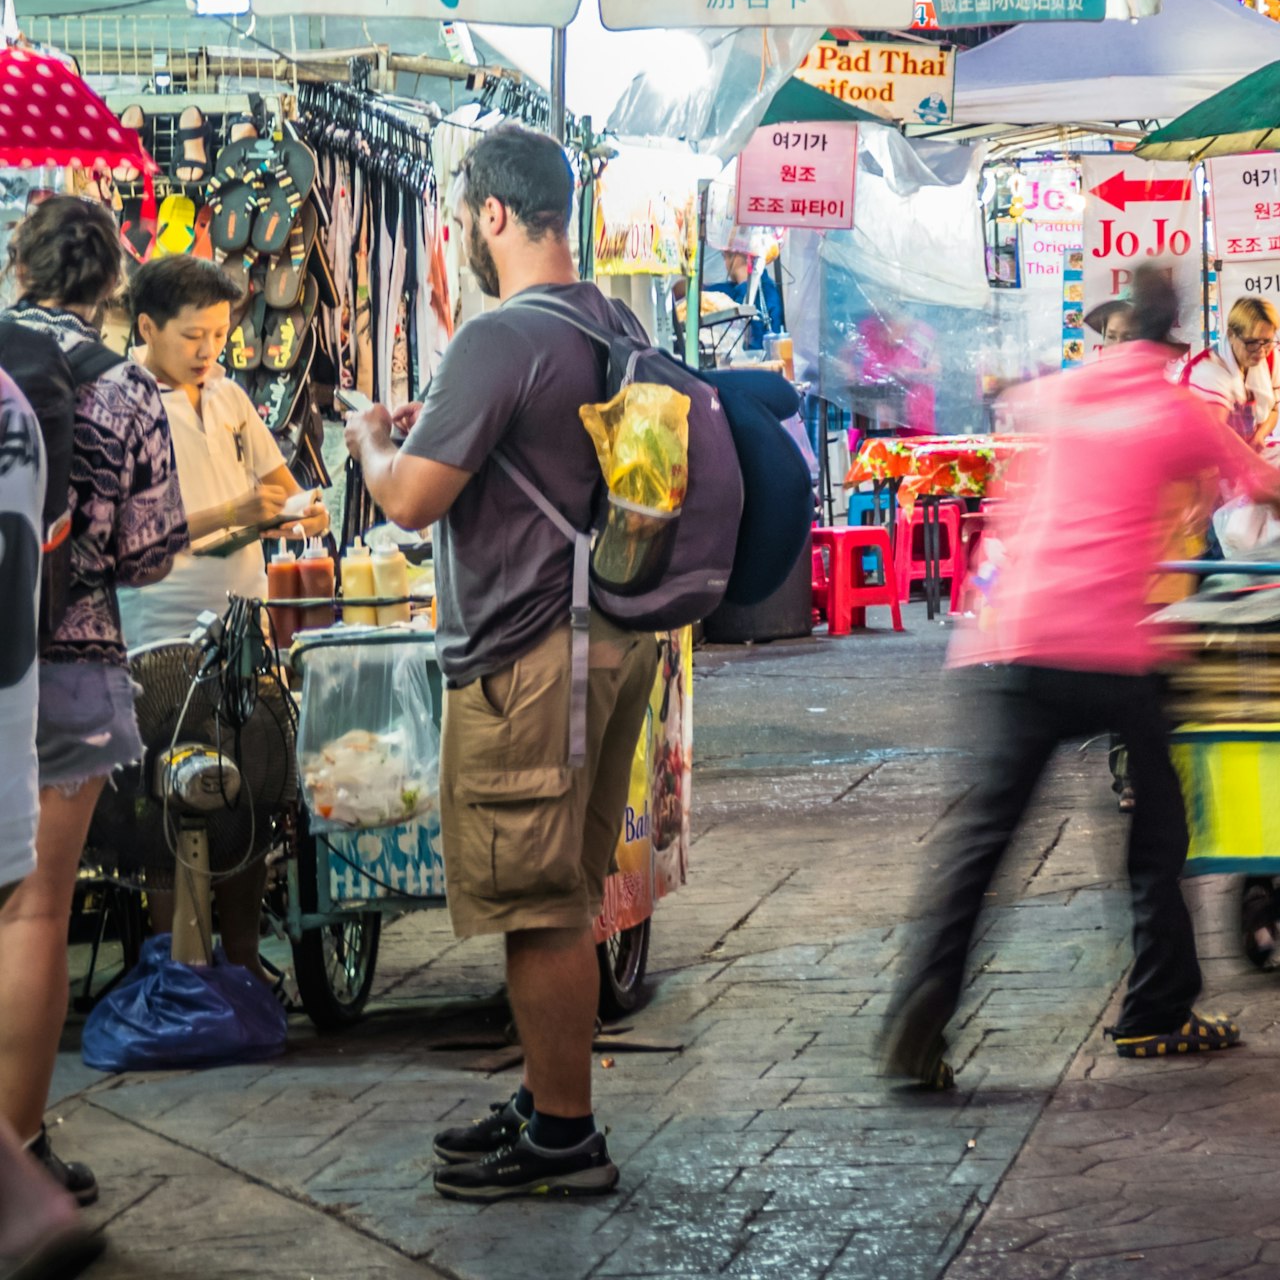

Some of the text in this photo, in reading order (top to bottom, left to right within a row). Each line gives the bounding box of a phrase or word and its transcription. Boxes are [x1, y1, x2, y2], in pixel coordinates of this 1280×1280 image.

[818, 46, 946, 76] Pad Thai
[816, 80, 894, 102] aifood
[772, 131, 828, 153] 여기가
[779, 164, 817, 184] 원조
[747, 196, 845, 218] 조조 파타이
[1033, 240, 1083, 255] Origin
[1227, 237, 1263, 255] 조조
[1026, 262, 1060, 275] Thai
